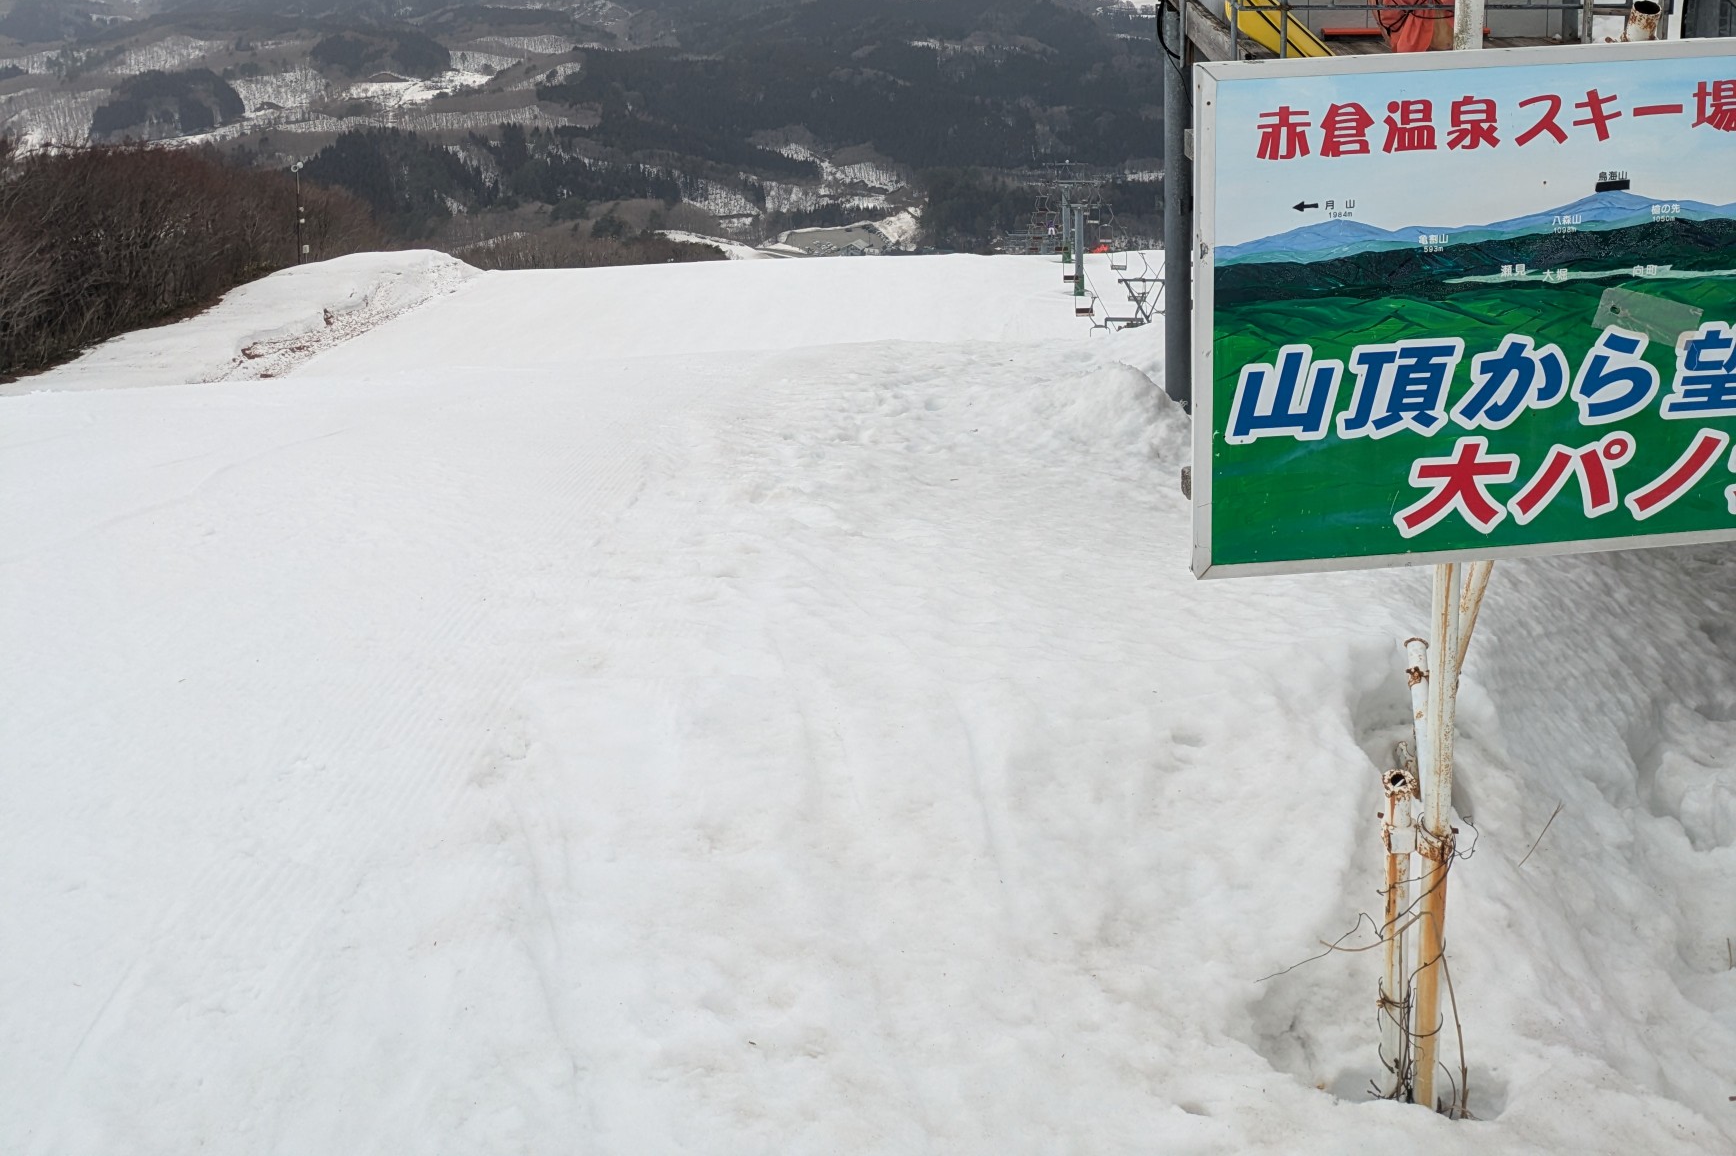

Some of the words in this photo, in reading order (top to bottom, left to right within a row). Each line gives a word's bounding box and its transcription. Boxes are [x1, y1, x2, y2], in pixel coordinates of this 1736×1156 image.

[1256, 80, 1736, 161] 赤倉温泉スキー場
[1597, 170, 1629, 182] 鳥海山
[1328, 211, 1353, 219] 1984m
[1551, 214, 1582, 226] 八森山
[1423, 245, 1444, 253] 593m
[1500, 263, 1527, 278] 瀬見
[1542, 268, 1568, 282] 大堀
[1632, 264, 1658, 278] 向町
[1230, 328, 1736, 438] 山頂から望
[1400, 434, 1736, 532] 大パノ
